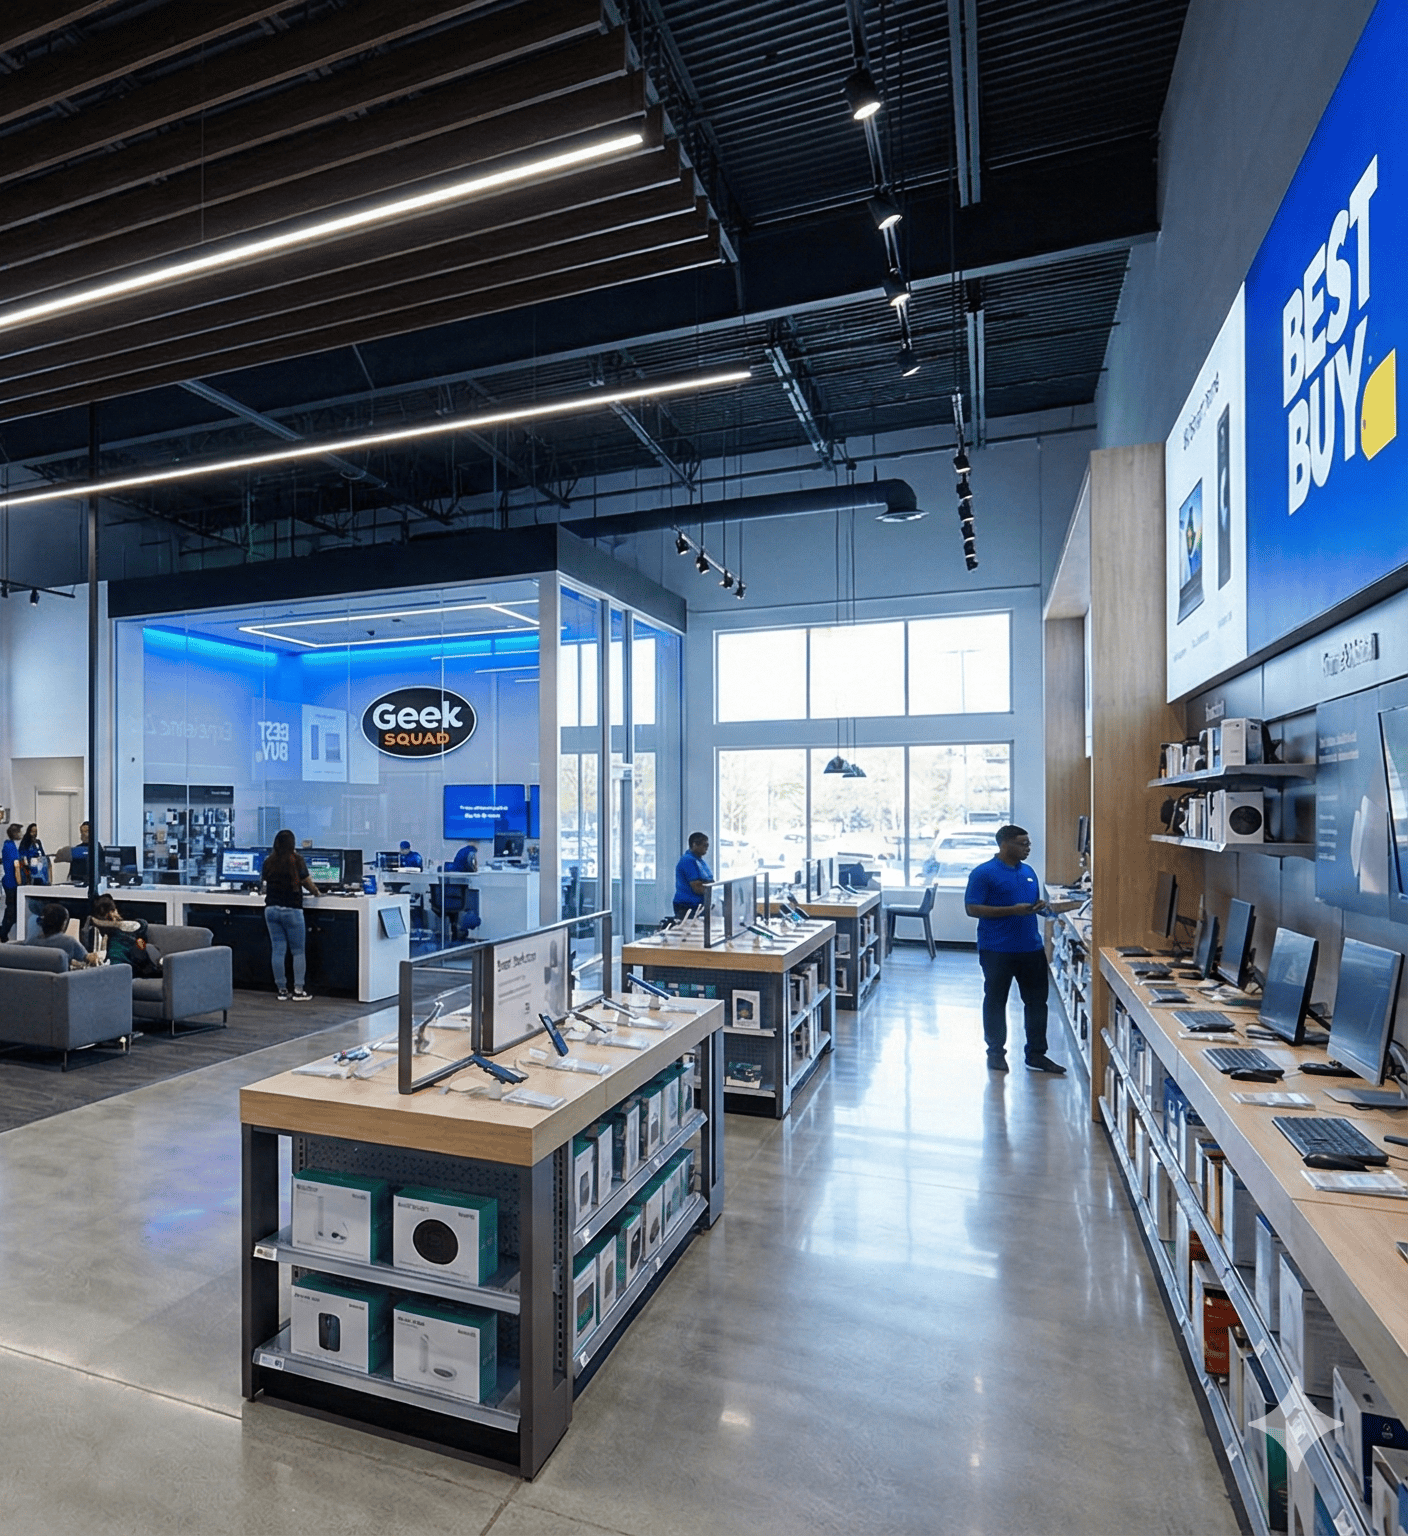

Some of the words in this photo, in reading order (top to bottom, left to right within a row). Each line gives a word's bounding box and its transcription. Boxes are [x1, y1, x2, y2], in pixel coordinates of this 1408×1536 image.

[1283, 153, 1378, 408] BEST
[1288, 314, 1368, 516] BUY
[372, 700, 464, 731] Geek
[384, 732, 450, 746] SQUAD
